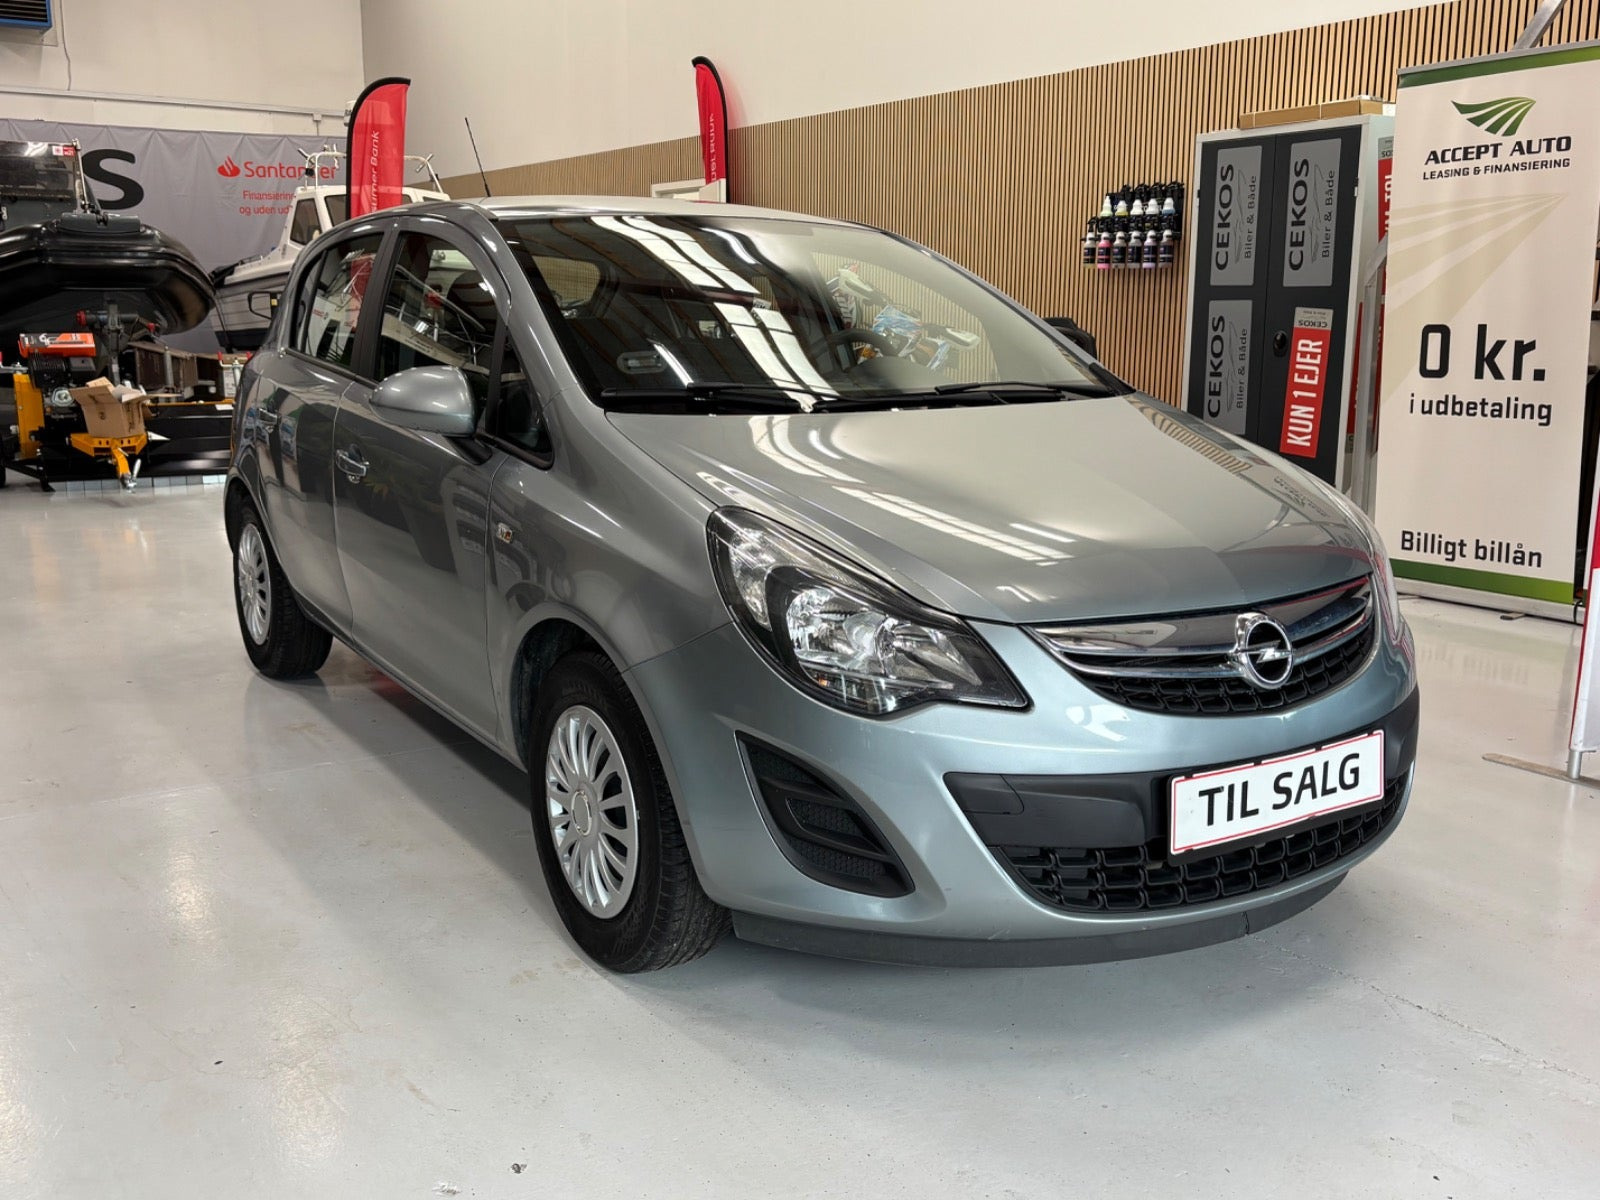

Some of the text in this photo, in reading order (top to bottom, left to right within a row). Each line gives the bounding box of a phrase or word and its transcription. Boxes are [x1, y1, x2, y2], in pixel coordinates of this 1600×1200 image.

[370, 130, 379, 166] Bank
[1424, 136, 1572, 165] ACCEPT AUTO
[243, 161, 336, 178] Santaner
[1423, 158, 1570, 180] LEASING & FINANSIERING
[1215, 164, 1234, 271] CEKOS
[1247, 212, 1254, 224] &
[1289, 158, 1310, 271] CEKOS
[1322, 170, 1335, 258] Biler & Både
[1245, 229, 1254, 259] Biler
[1208, 315, 1225, 418] CEKOS
[1294, 339, 1323, 385] EJER
[1419, 324, 1546, 381] 0 kr.
[1238, 367, 1246, 376] &
[1236, 380, 1245, 409] Biler
[1410, 393, 1552, 427] i udbetaling
[1287, 404, 1315, 447] KUN
[1401, 530, 1542, 568] Billigt billån
[1198, 753, 1360, 827] TIL SALG
